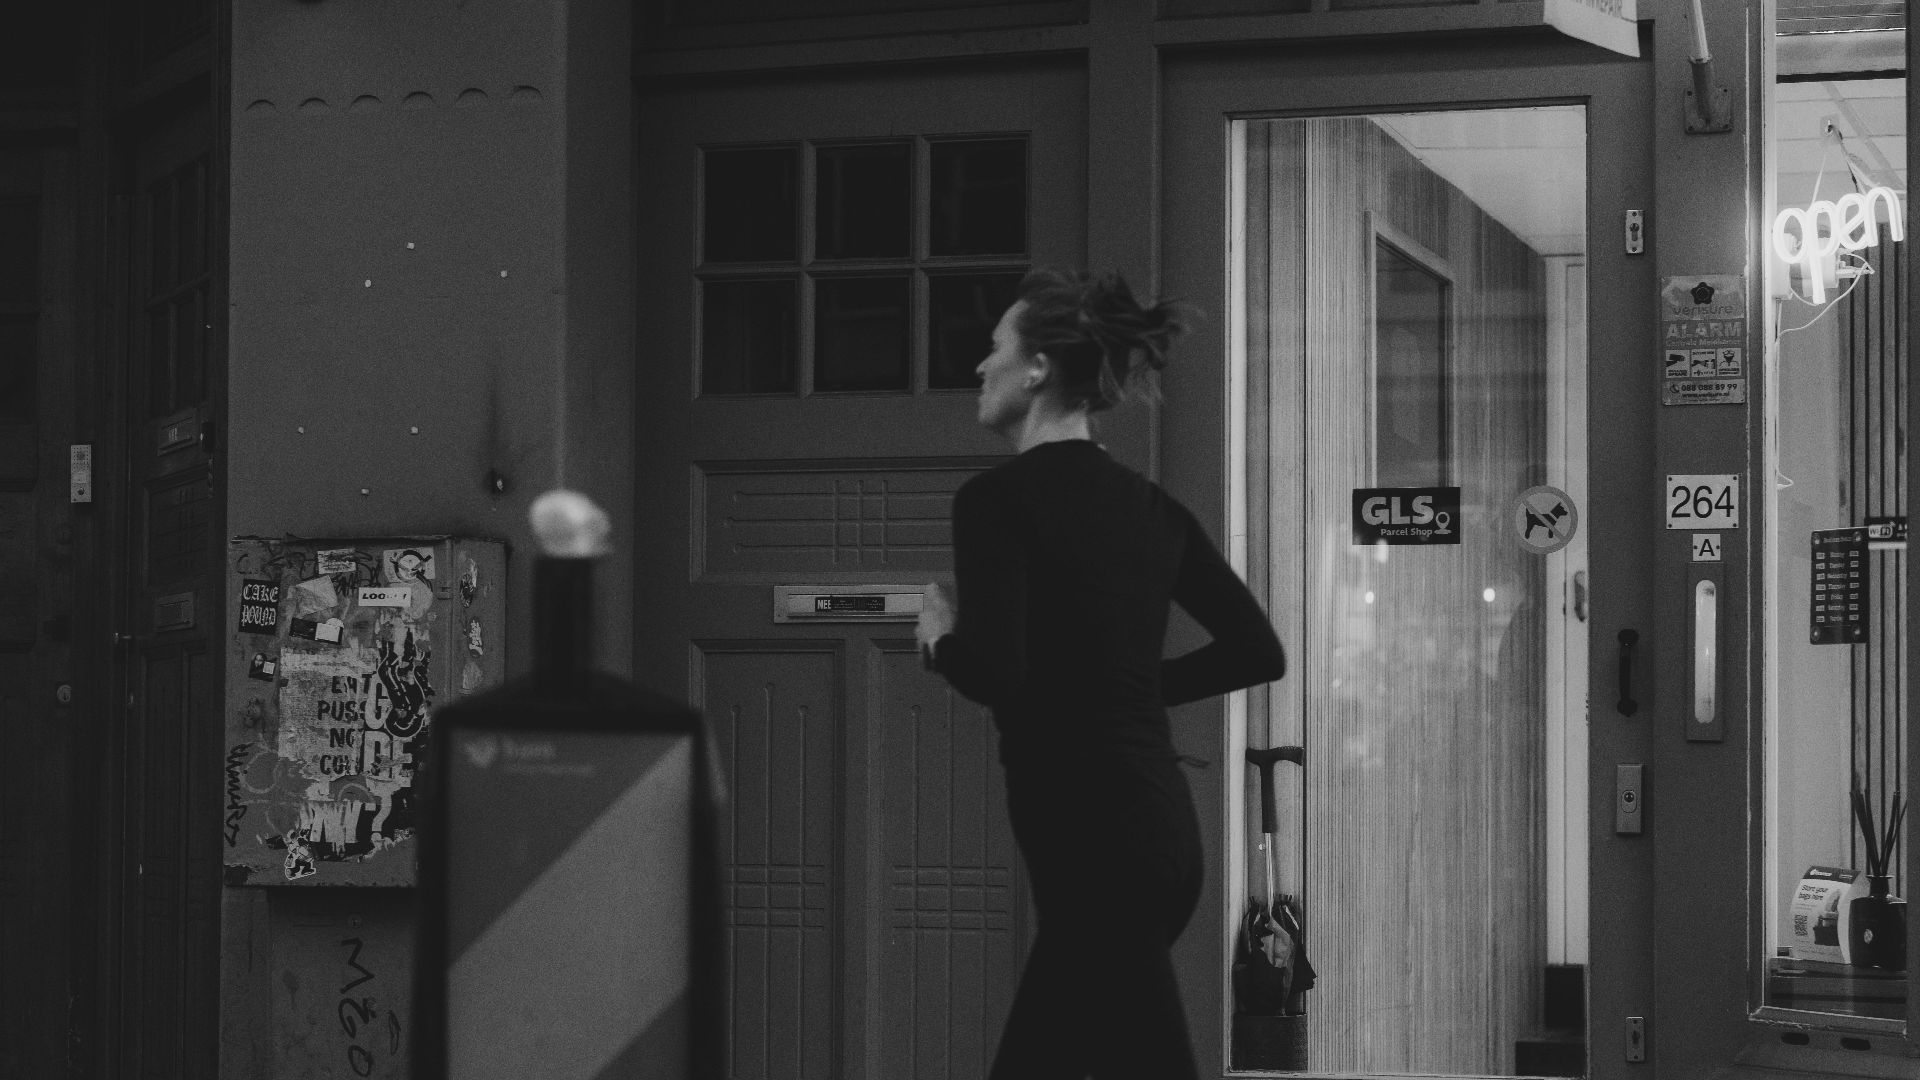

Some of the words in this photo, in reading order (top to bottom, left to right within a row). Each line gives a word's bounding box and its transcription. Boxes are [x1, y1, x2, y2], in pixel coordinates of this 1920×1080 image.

[1772, 187, 1904, 304] open
[1666, 322, 1742, 338] ALARM
[1361, 495, 1434, 526] GLS
[1671, 485, 1735, 518] 264
[1381, 528, 1408, 536] Parcel
[1411, 527, 1433, 537] Shop
[1699, 538, 1715, 556] A
[817, 599, 832, 610] NEE
